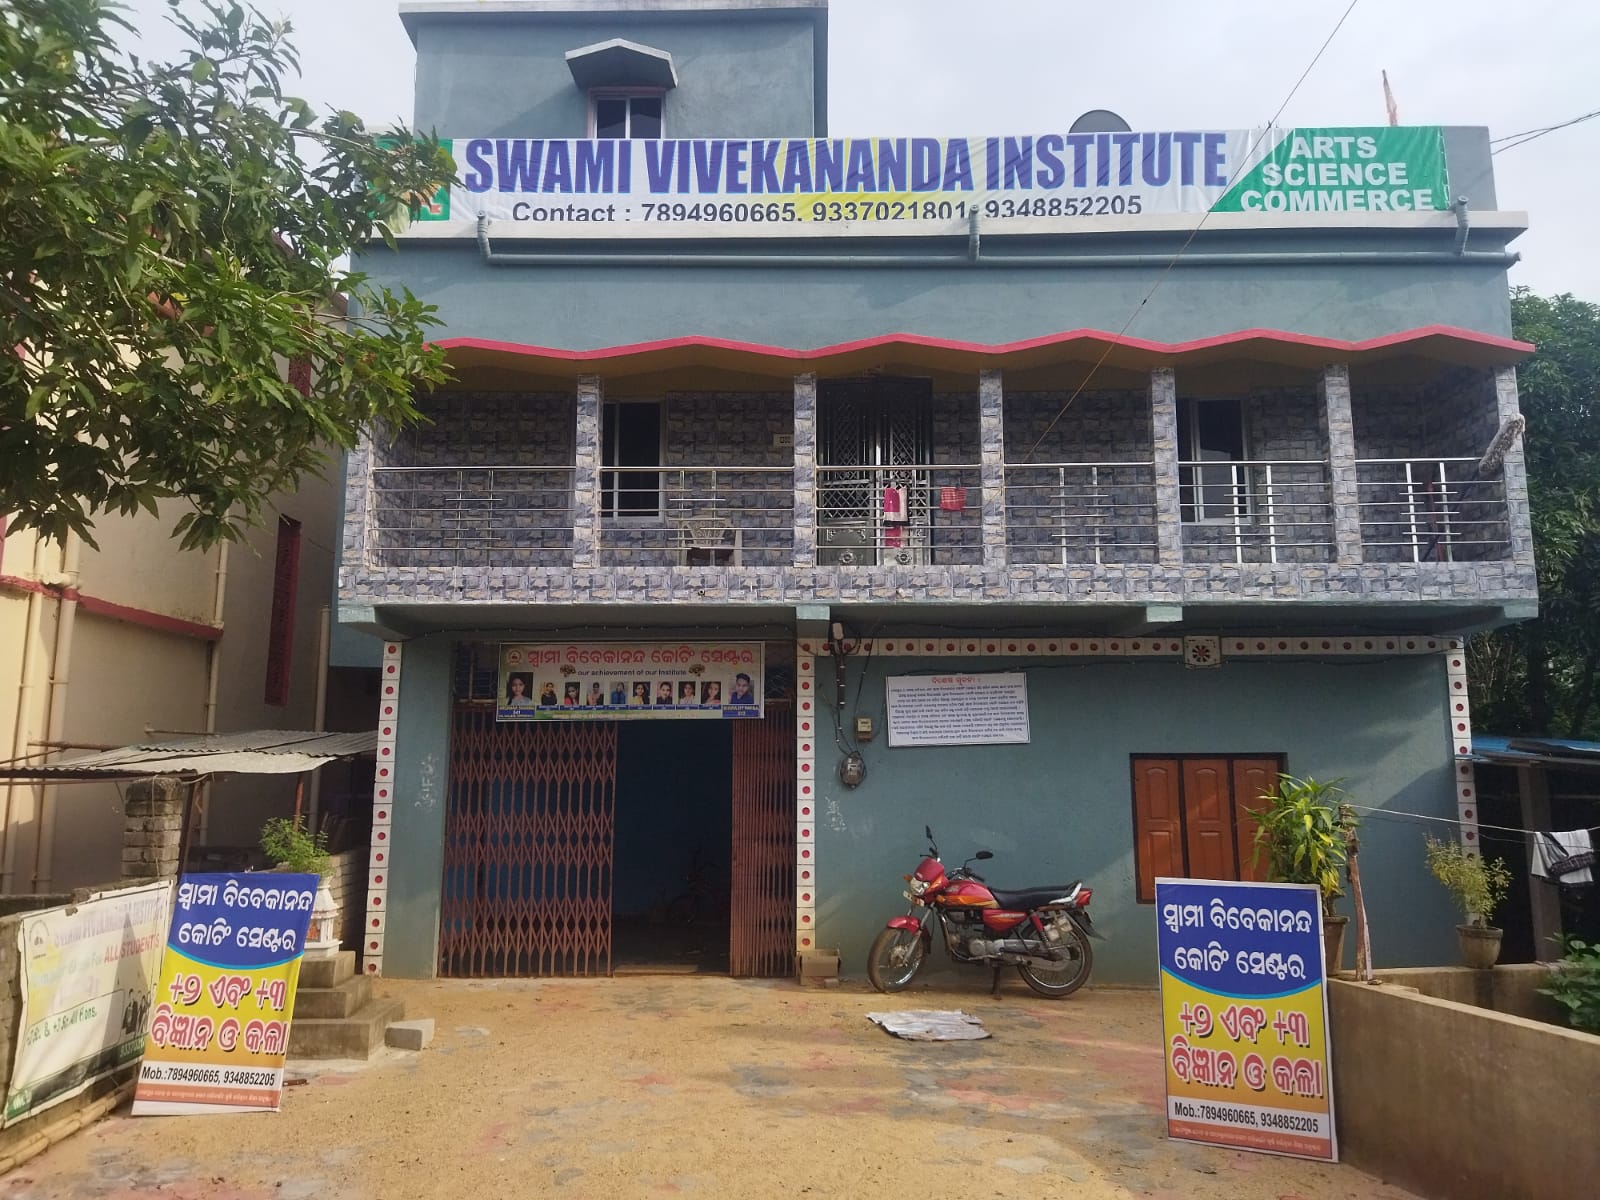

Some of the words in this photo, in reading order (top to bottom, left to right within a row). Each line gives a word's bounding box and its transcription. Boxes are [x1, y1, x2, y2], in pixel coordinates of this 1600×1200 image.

[464, 138, 631, 194] SWAMI
[644, 136, 975, 194] VIVEKANANDA
[985, 132, 1227, 192] INSTITUTE
[1289, 136, 1377, 159] ARTS
[1262, 162, 1409, 187] SCIENCE
[512, 201, 616, 221] Contact
[985, 195, 1142, 218] 9348852205
[1240, 189, 1436, 212] COMMERCE
[222, 879, 314, 911] ବିବେକାନନ୍ଦ
[1209, 897, 1313, 934] ବିବେକାନନ୍ଦ
[178, 917, 232, 946] କୋଚିଂ
[236, 926, 297, 953] ସେଣ୍ଟର
[1174, 940, 1230, 972] କୋଚିଂ
[1235, 950, 1307, 981] ସେଣ୍ଟର
[208, 974, 252, 1009] ଏବଂ
[1219, 1004, 1267, 1043] ଏବଂ
[223, 1069, 276, 1087] 9348852205
[1260, 1111, 1319, 1133] 9348852205
